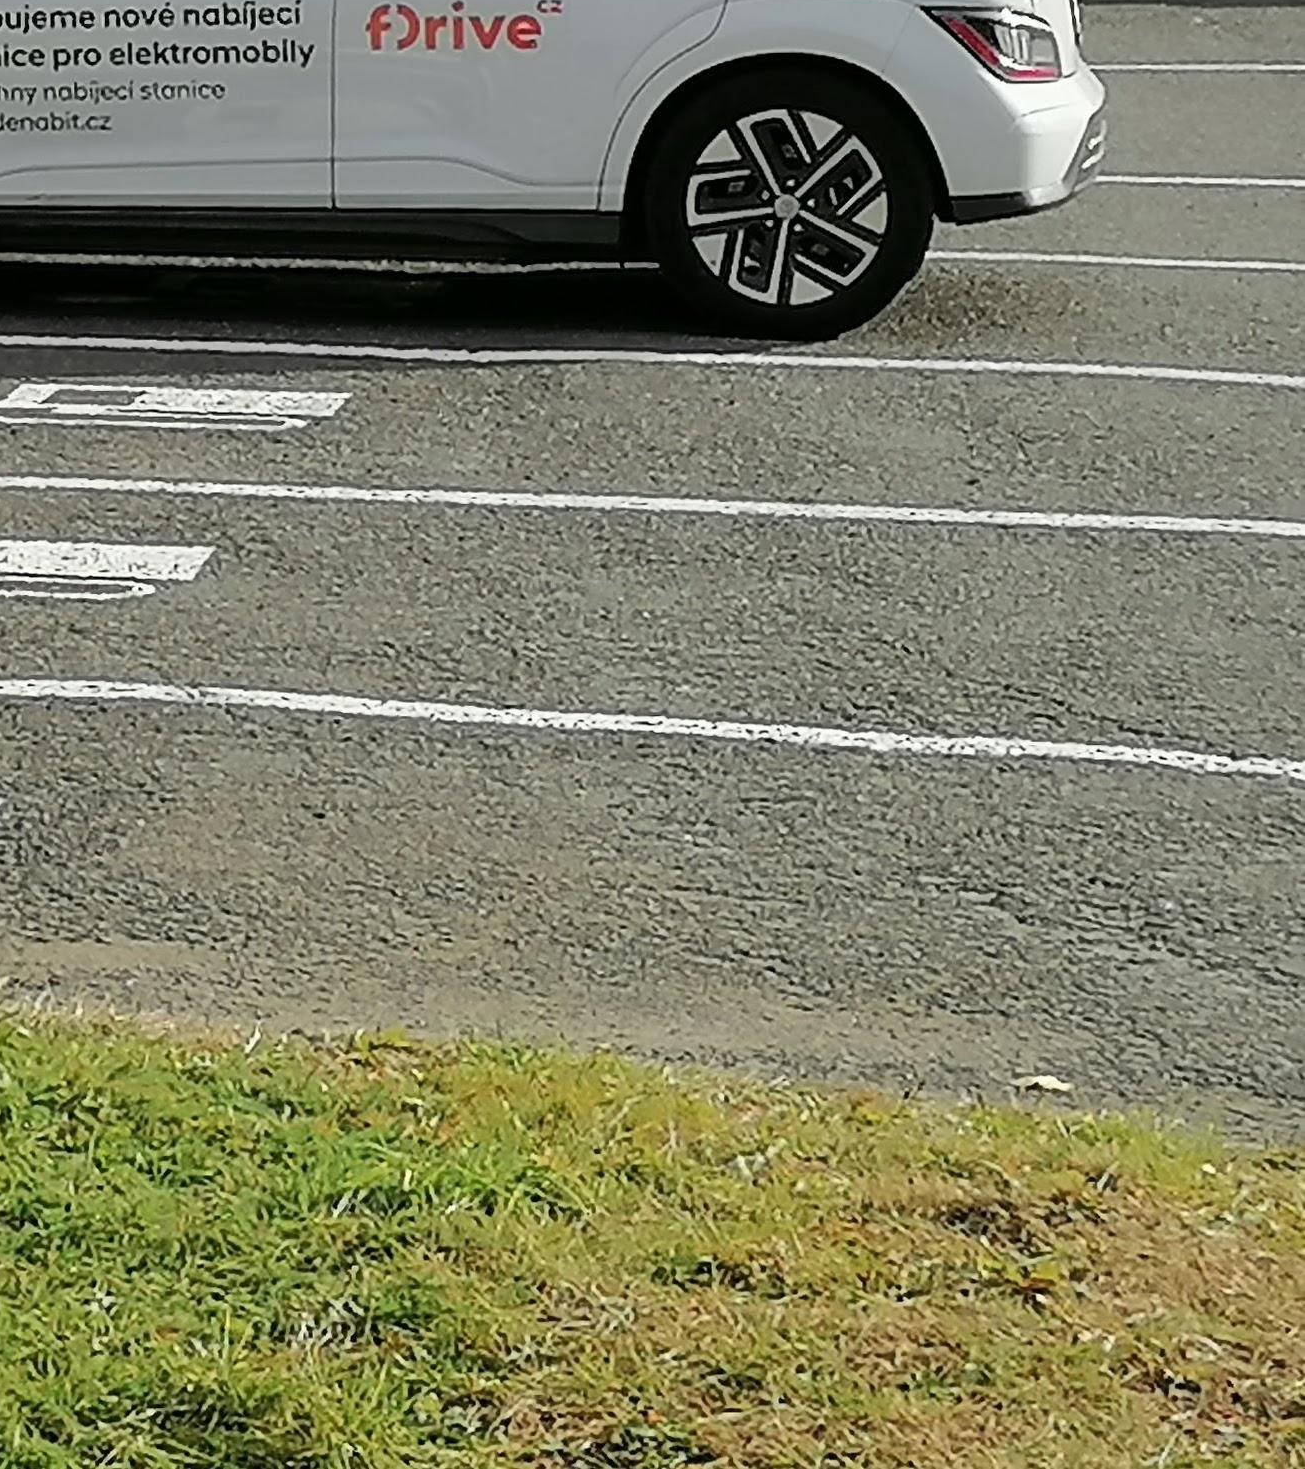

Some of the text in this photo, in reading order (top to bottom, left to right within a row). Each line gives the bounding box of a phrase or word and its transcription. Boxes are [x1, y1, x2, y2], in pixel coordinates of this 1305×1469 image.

[104, 1, 175, 28] nové
[183, 0, 301, 31] nabíjecí
[53, 48, 102, 72] pro
[109, 38, 315, 68] elektromobily
[43, 80, 134, 105] nabíjecí
[139, 80, 226, 101] stanice
